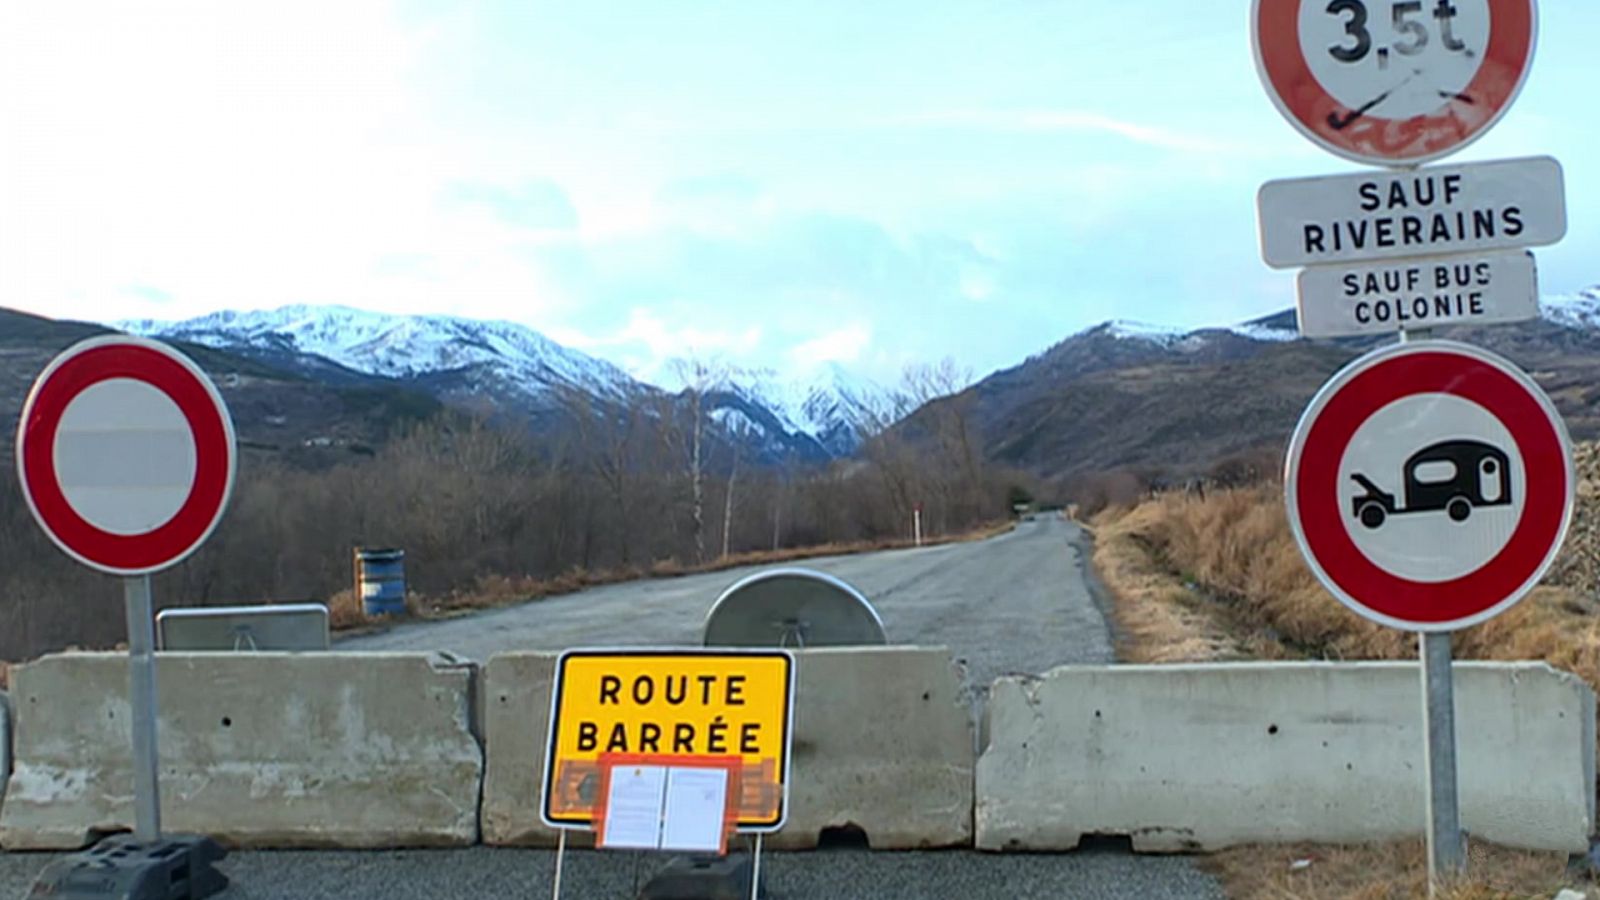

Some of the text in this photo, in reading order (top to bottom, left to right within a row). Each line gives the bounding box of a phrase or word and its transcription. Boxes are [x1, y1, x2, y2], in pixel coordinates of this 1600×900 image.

[1359, 175, 1461, 211] SAUF
[1304, 207, 1524, 253] RIVERAINS
[1343, 263, 1491, 296] SAUF BUS
[1355, 293, 1484, 323] COLONIE
[599, 675, 747, 705] ROUTE
[577, 715, 761, 753] BARRÉE
